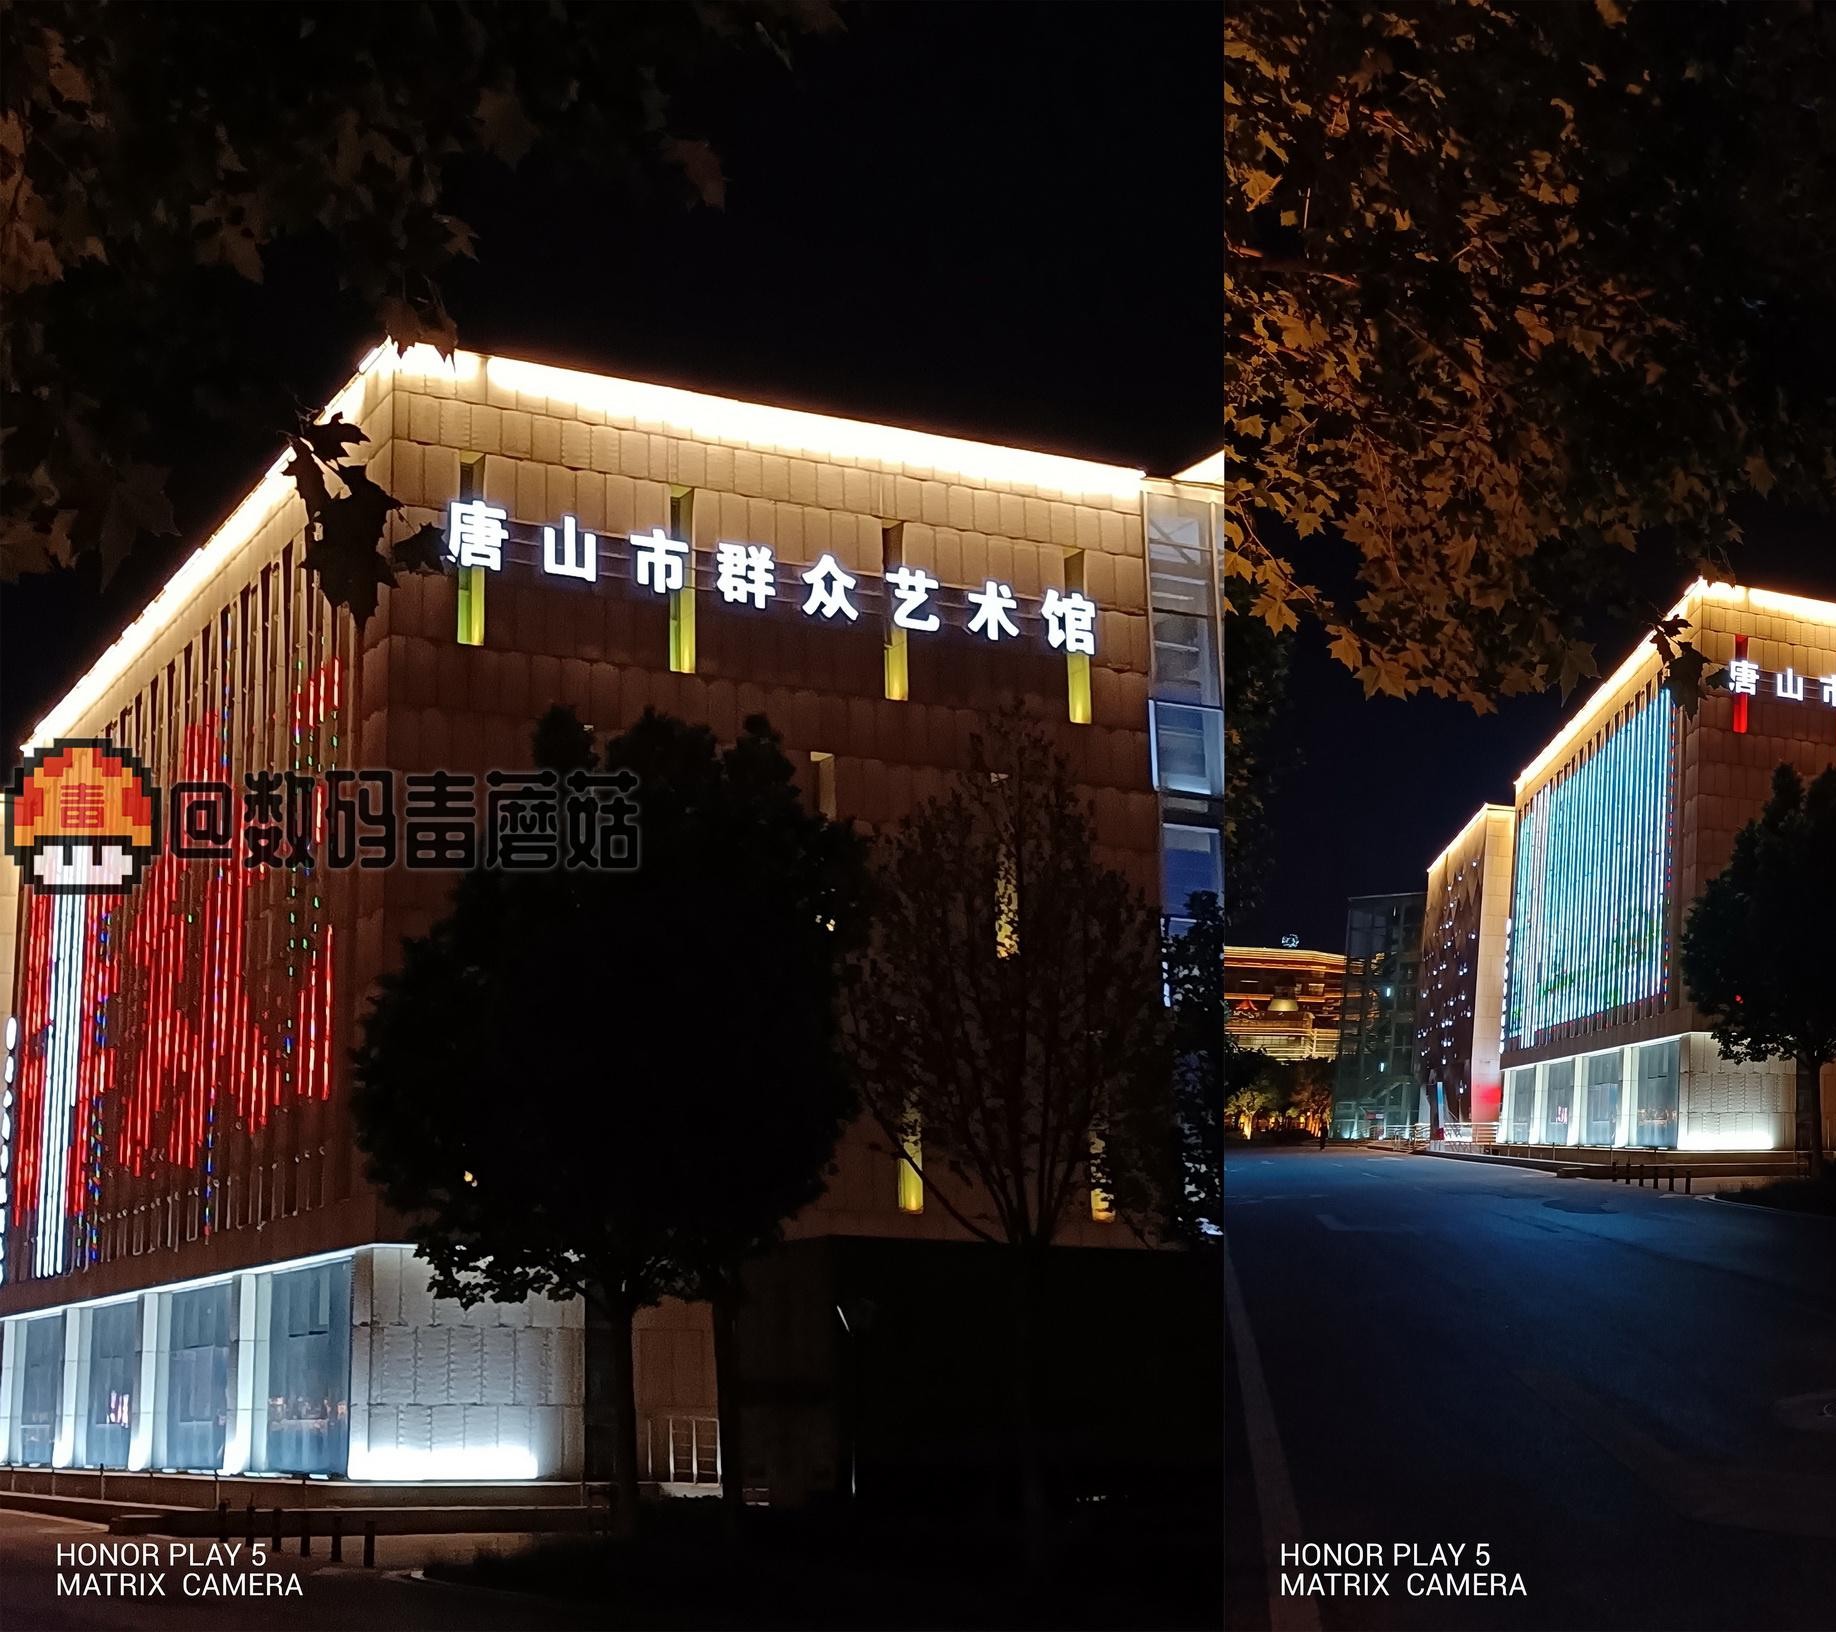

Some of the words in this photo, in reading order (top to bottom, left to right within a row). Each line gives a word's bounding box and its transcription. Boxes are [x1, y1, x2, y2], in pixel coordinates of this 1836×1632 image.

[446, 499, 1098, 656] 唐山市群众艺术馆
